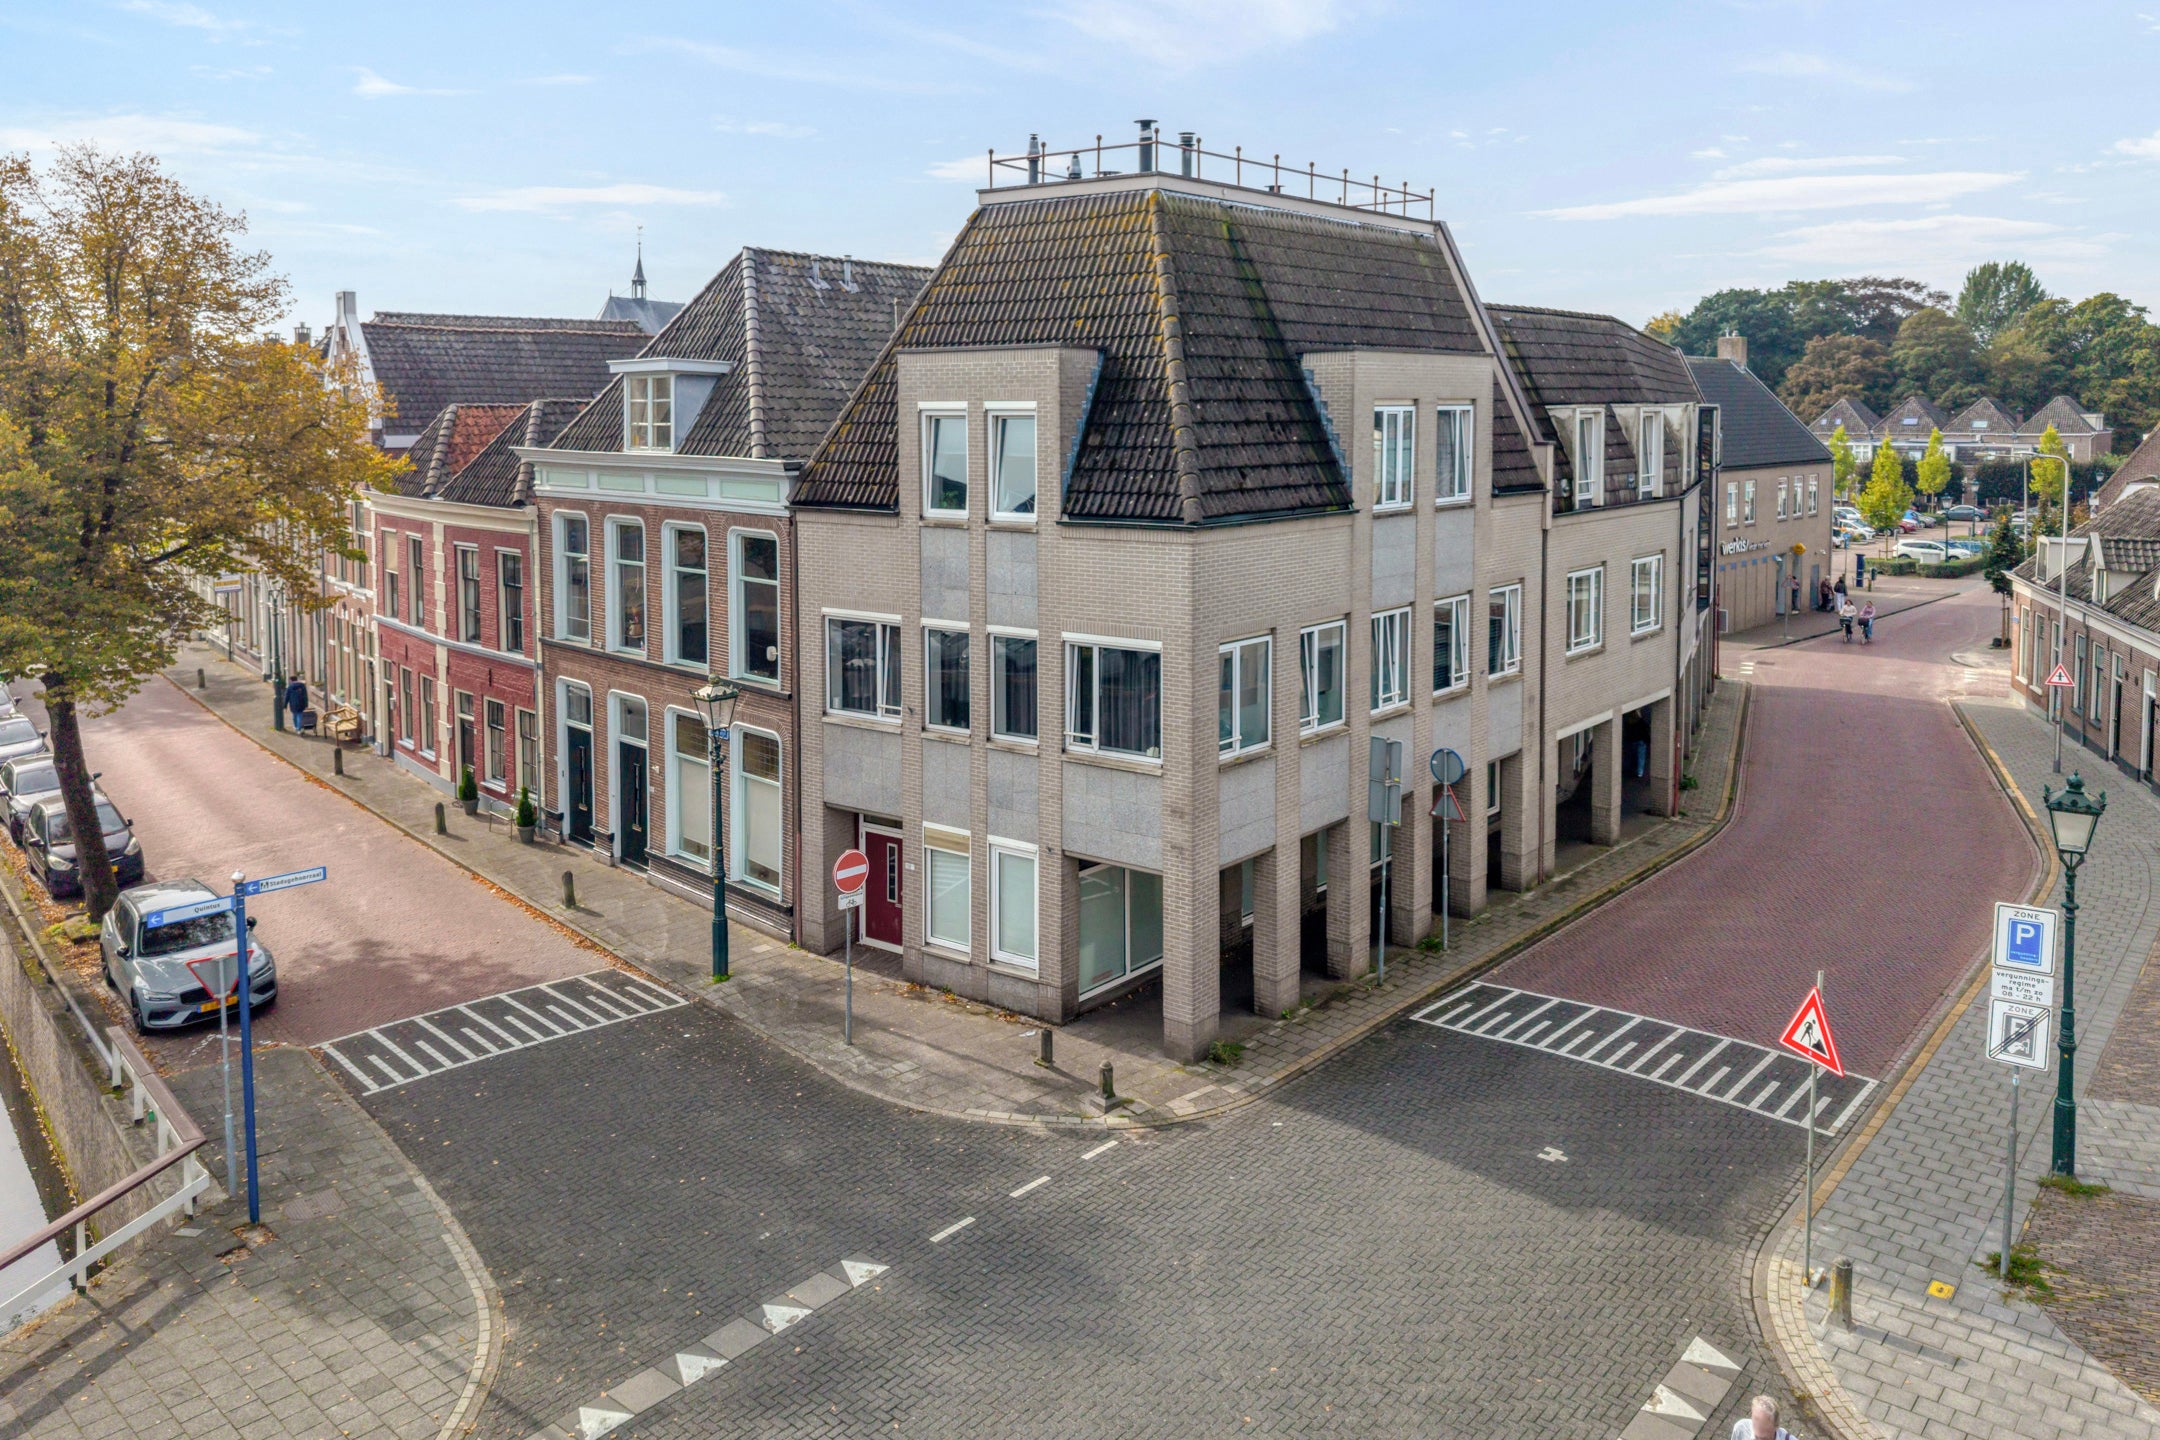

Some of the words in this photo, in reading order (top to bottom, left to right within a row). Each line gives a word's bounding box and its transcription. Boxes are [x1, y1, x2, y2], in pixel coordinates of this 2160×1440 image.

[194, 902, 221, 914] Quintus
[2013, 910, 2041, 920] ZONE
[2015, 923, 2035, 945] P
[1996, 971, 2050, 984] vergunnings-
[2009, 980, 2036, 989] regime
[2016, 986, 2031, 994] t/m
[2022, 993, 2033, 1001] 22
[2008, 1005, 2035, 1016] ZONE
